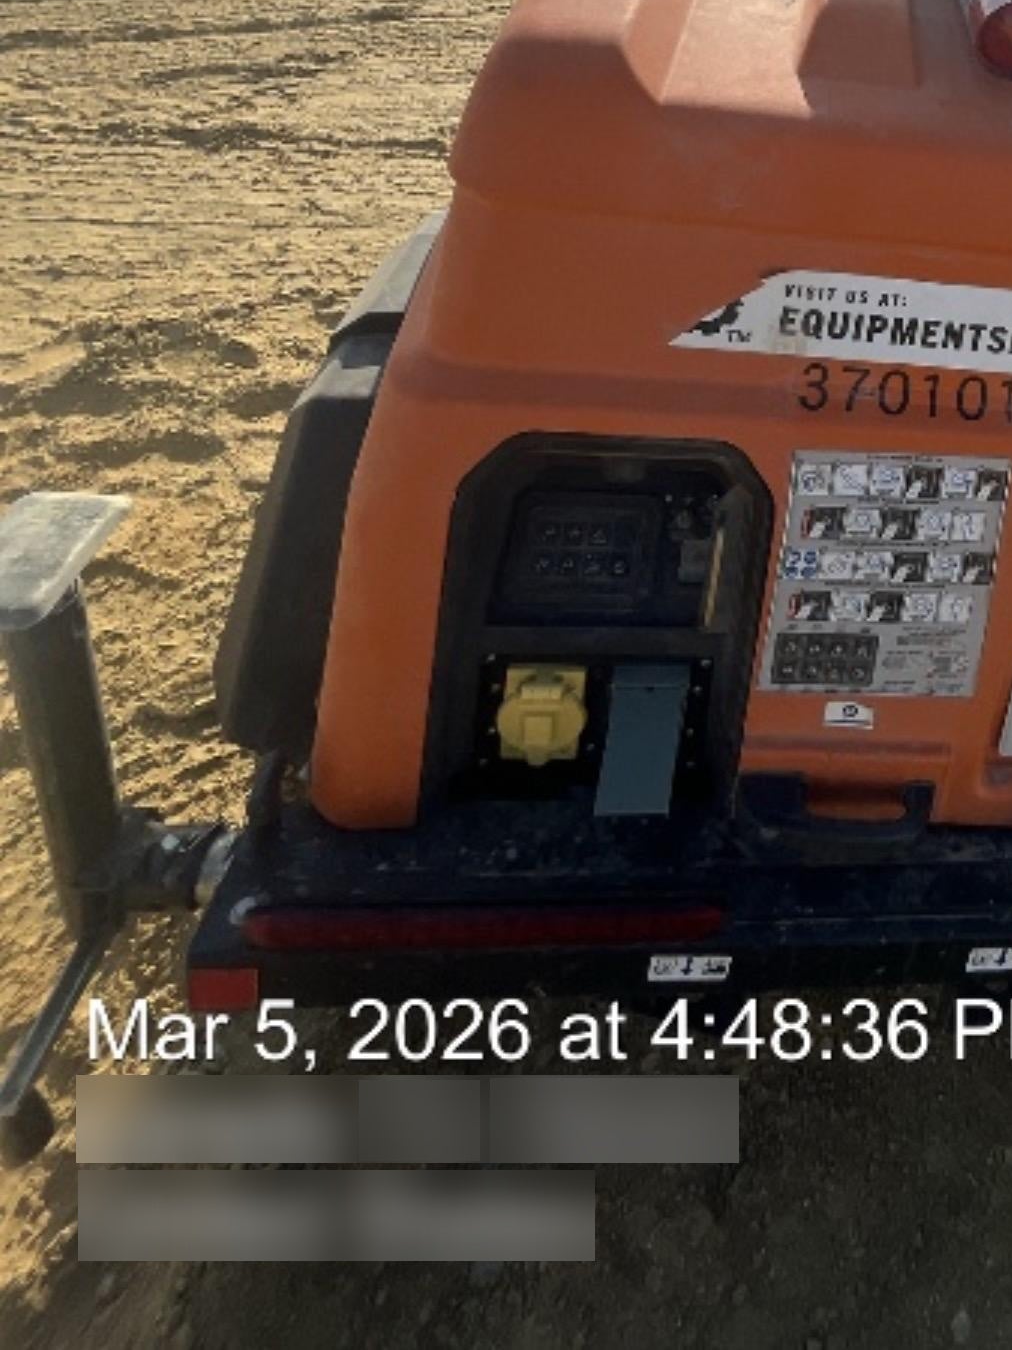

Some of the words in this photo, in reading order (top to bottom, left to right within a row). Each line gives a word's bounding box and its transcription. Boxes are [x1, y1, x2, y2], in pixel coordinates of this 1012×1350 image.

[785, 284, 837, 301] VISIT
[846, 290, 868, 303] US
[879, 293, 907, 306] AT:
